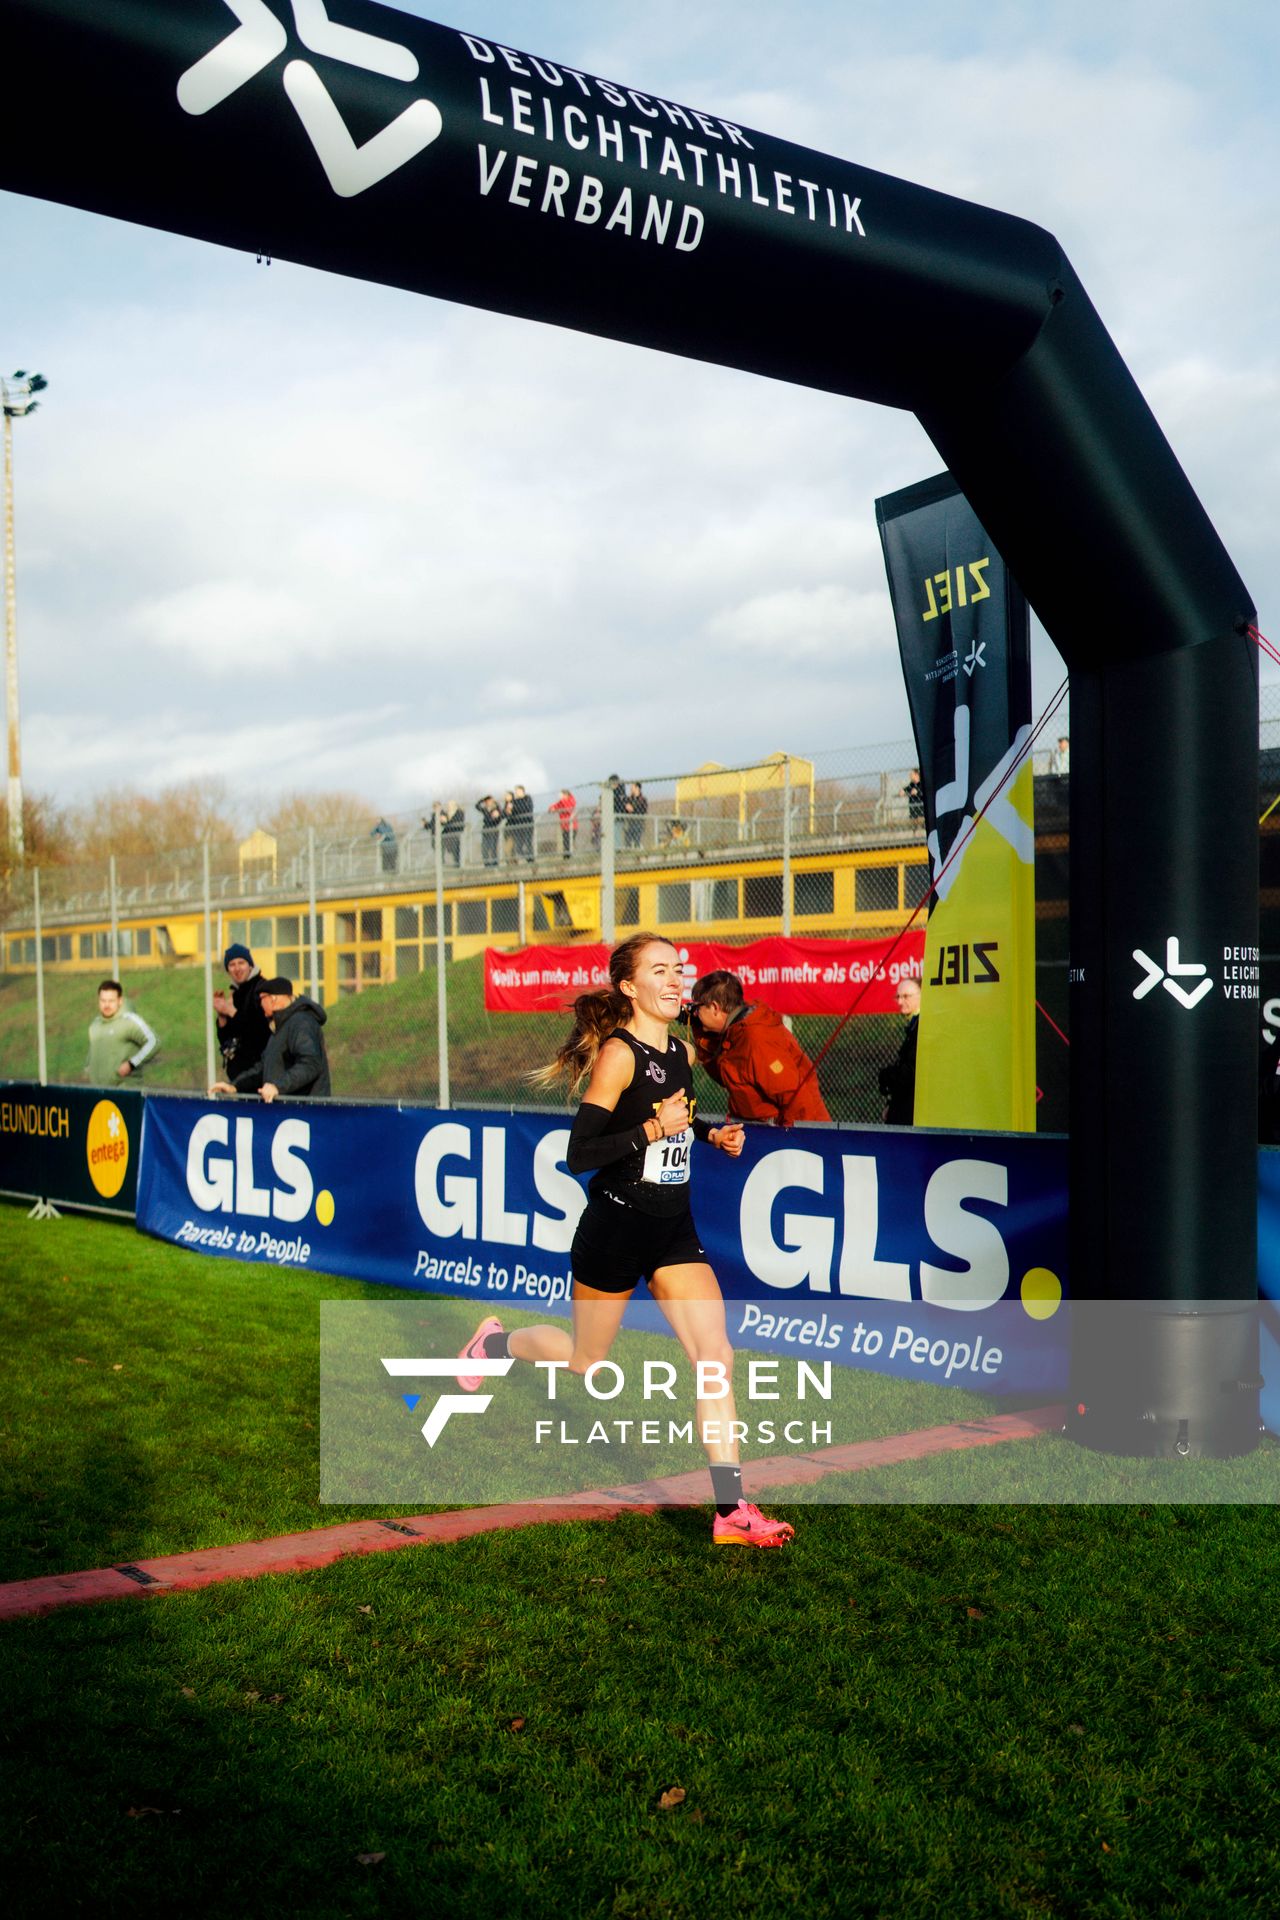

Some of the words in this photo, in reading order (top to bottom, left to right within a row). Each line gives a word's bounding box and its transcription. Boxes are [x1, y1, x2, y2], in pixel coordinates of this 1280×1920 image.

[460, 33, 754, 150] DEUTSCHER
[479, 77, 866, 237] LEICHTATHLETIK
[477, 144, 705, 252] VERBAND
[522, 970, 540, 986] um
[542, 967, 571, 985] mehr
[572, 966, 589, 985] als
[758, 967, 778, 984] um
[781, 961, 821, 983] mehr
[822, 962, 845, 983] als
[0, 1103, 70, 1138] EUNDLICH
[91, 1140, 125, 1165] entega
[661, 1146, 688, 1167] 104
[175, 1220, 236, 1250] Parcels
[236, 1228, 256, 1251] to
[258, 1232, 311, 1264] People
[414, 1250, 481, 1287] Parcels
[487, 1262, 508, 1290] to
[512, 1264, 572, 1307] Peopl
[738, 1303, 844, 1349] Parcels
[851, 1322, 883, 1355] to
[889, 1325, 1003, 1379] People
